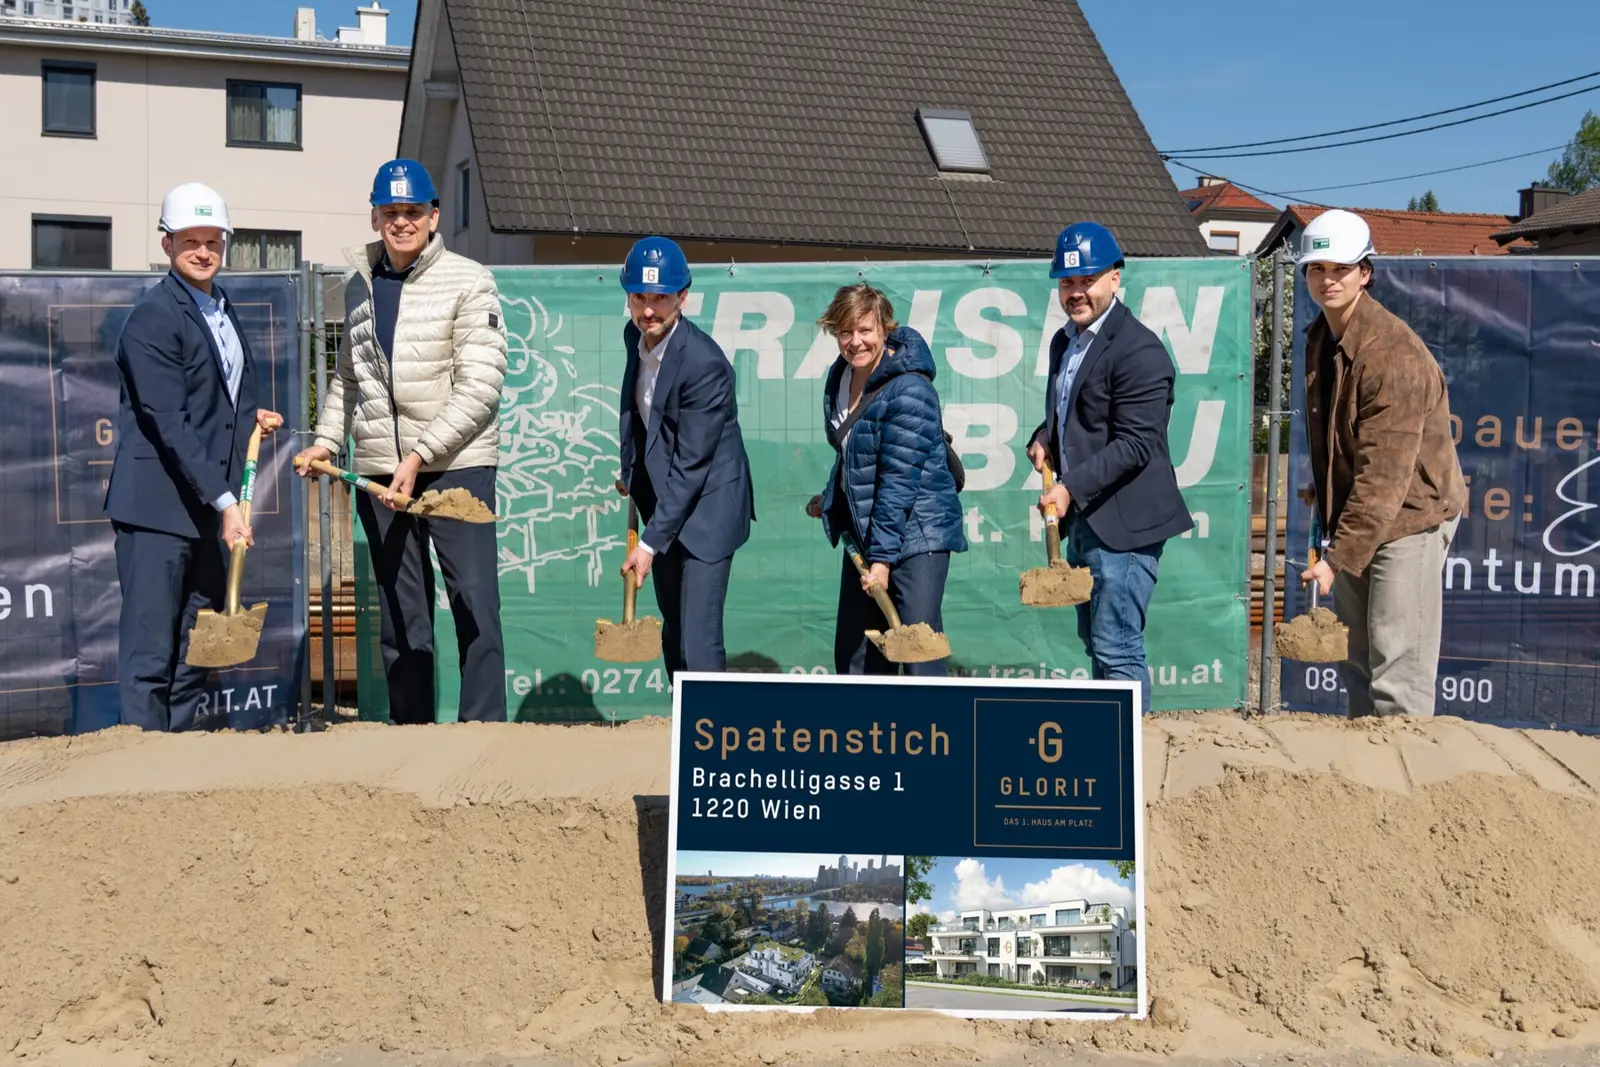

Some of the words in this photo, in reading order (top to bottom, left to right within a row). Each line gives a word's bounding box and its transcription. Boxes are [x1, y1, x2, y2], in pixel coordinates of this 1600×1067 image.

[942, 399, 1226, 491] BU
[1445, 548, 1596, 597] ntum
[581, 668, 673, 694] 0274
[1305, 666, 1347, 693] 08
[1442, 676, 1493, 704] 900
[196, 684, 278, 717] RIT.AT
[694, 718, 950, 760] Spatenstich
[692, 767, 881, 795] Brachelligasse
[893, 771, 905, 791] 1
[1000, 776, 1097, 797] GLORIT
[691, 797, 750, 819] 1220
[761, 799, 821, 820] Wien
[1003, 817, 1020, 826] DAS
[1031, 818, 1052, 827] HAUS
[1054, 819, 1066, 827] AM
[1068, 819, 1093, 828] PLATZ
